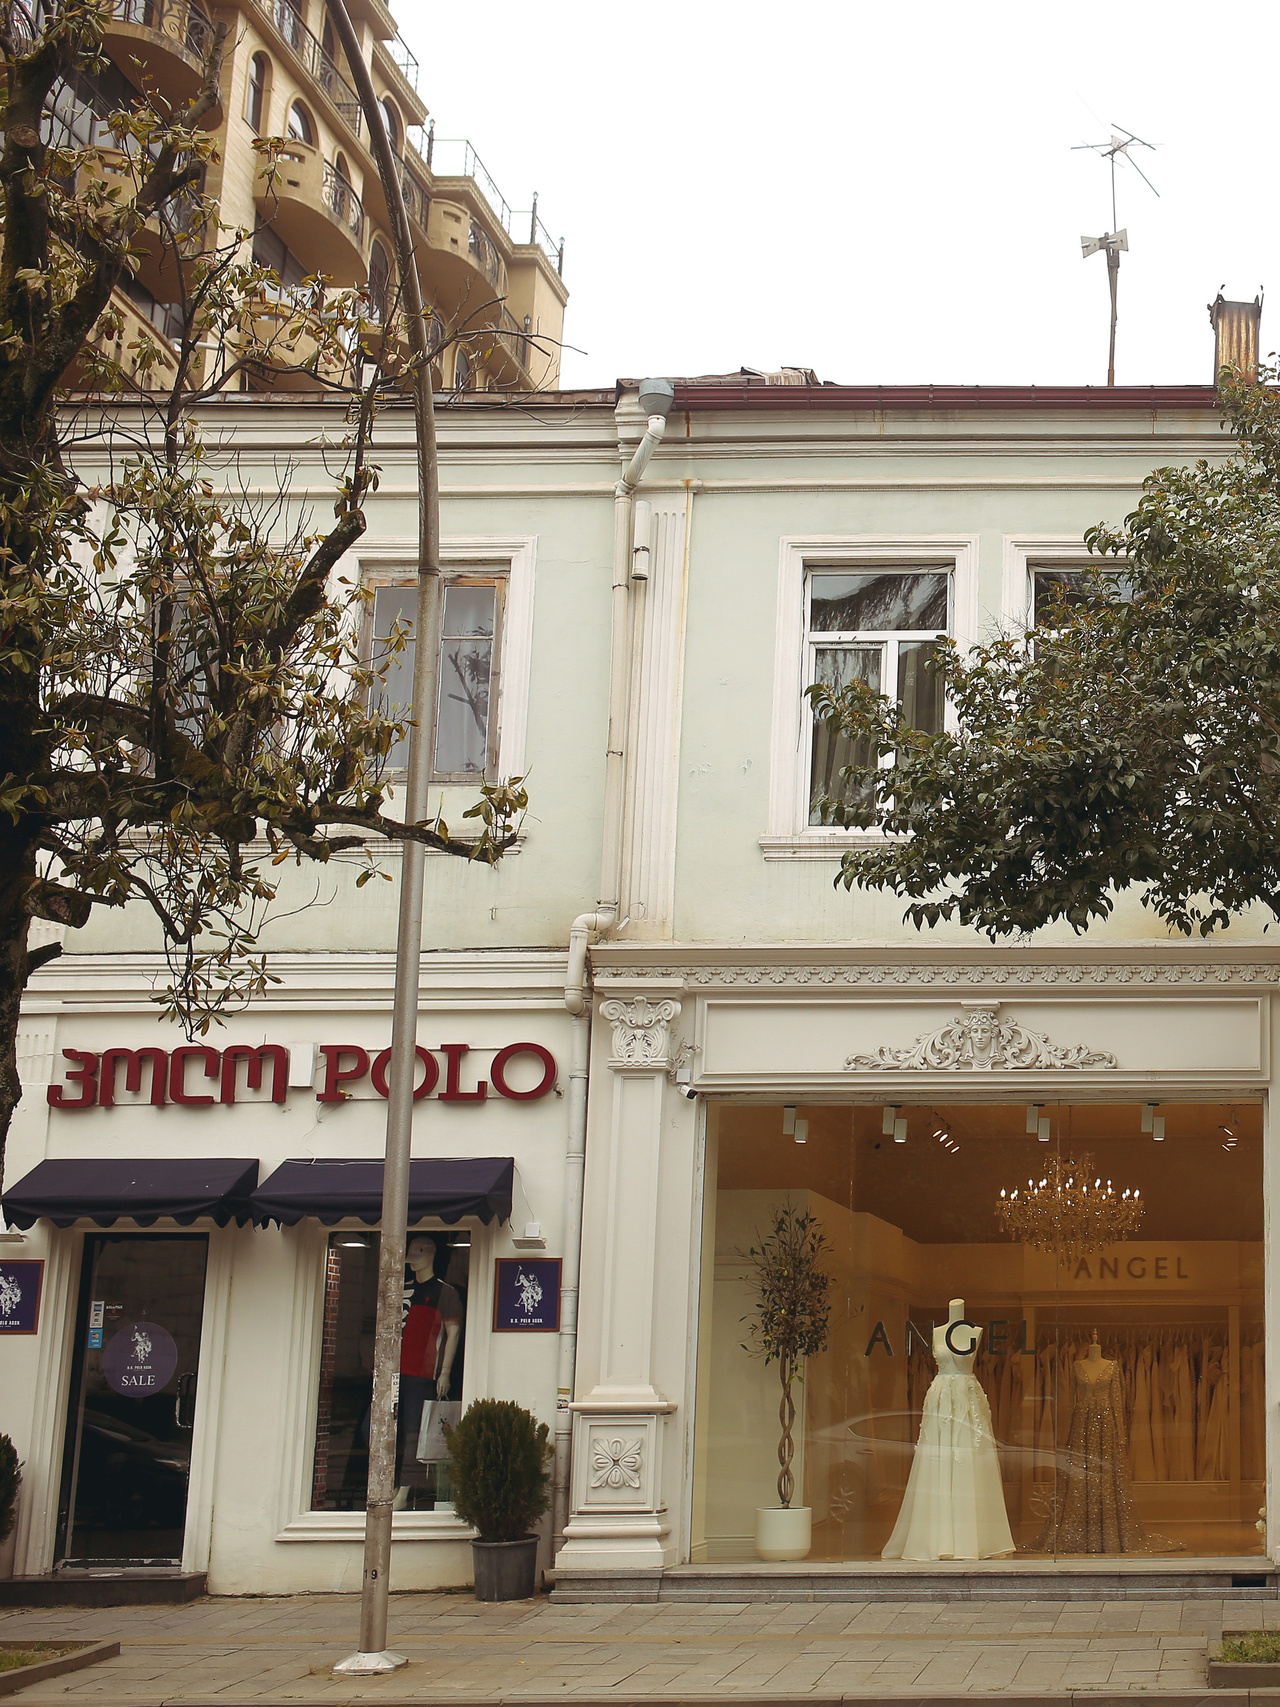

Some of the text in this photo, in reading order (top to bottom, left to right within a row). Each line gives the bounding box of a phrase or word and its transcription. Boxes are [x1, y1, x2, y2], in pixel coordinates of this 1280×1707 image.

[316, 1042, 558, 1102] POLO
[1074, 1256, 1189, 1279] ANGEL
[864, 1319, 1039, 1356] ANGEL
[121, 1375, 156, 1387] SALE
[364, 1569, 378, 1580] 19
